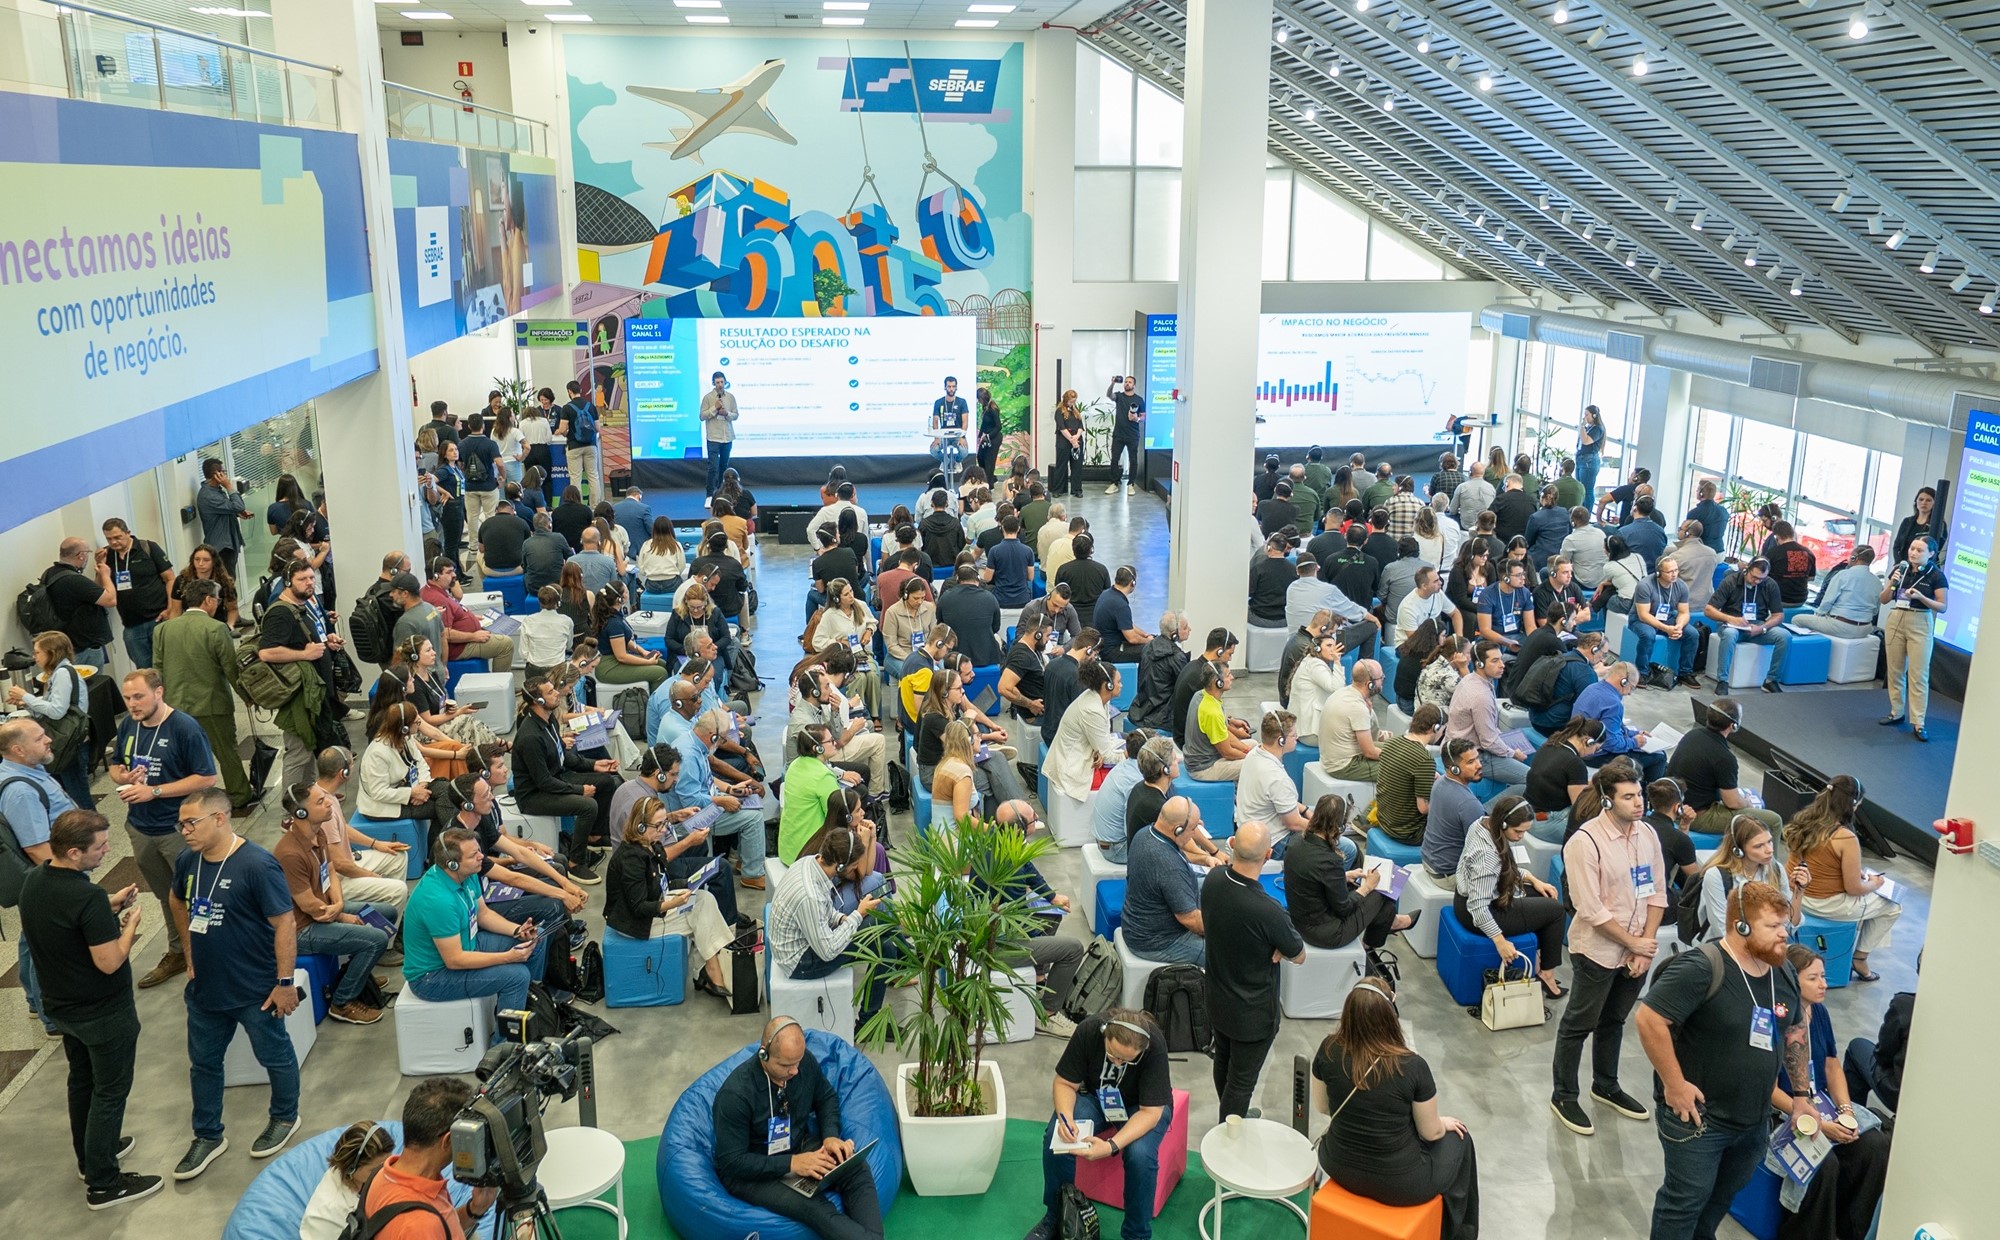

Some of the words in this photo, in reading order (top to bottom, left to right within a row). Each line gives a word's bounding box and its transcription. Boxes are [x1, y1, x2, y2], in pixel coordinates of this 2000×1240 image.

[928, 79, 985, 92] SEBRAE
[160, 212, 231, 266] ideias
[424, 246, 444, 264] SEBRAE
[37, 302, 85, 336] com
[90, 273, 216, 334] oportunidades
[1343, 317, 1388, 326] NEGÓCIO
[531, 329, 573, 337] INFORMAÇÕES
[720, 327, 788, 337] RESULTADO
[791, 327, 850, 337] ESPERADO
[854, 327, 871, 336] NA
[720, 337, 776, 350] SOLUÇÃO
[779, 338, 797, 348] DO
[801, 338, 849, 348] DESAFIO
[84, 340, 109, 380] de
[113, 324, 187, 376] negócio.
[1975, 421, 2000, 434] PALCO
[1973, 433, 1999, 446] CANAL
[1970, 472, 1987, 484] Código
[1957, 554, 1973, 564] Código
